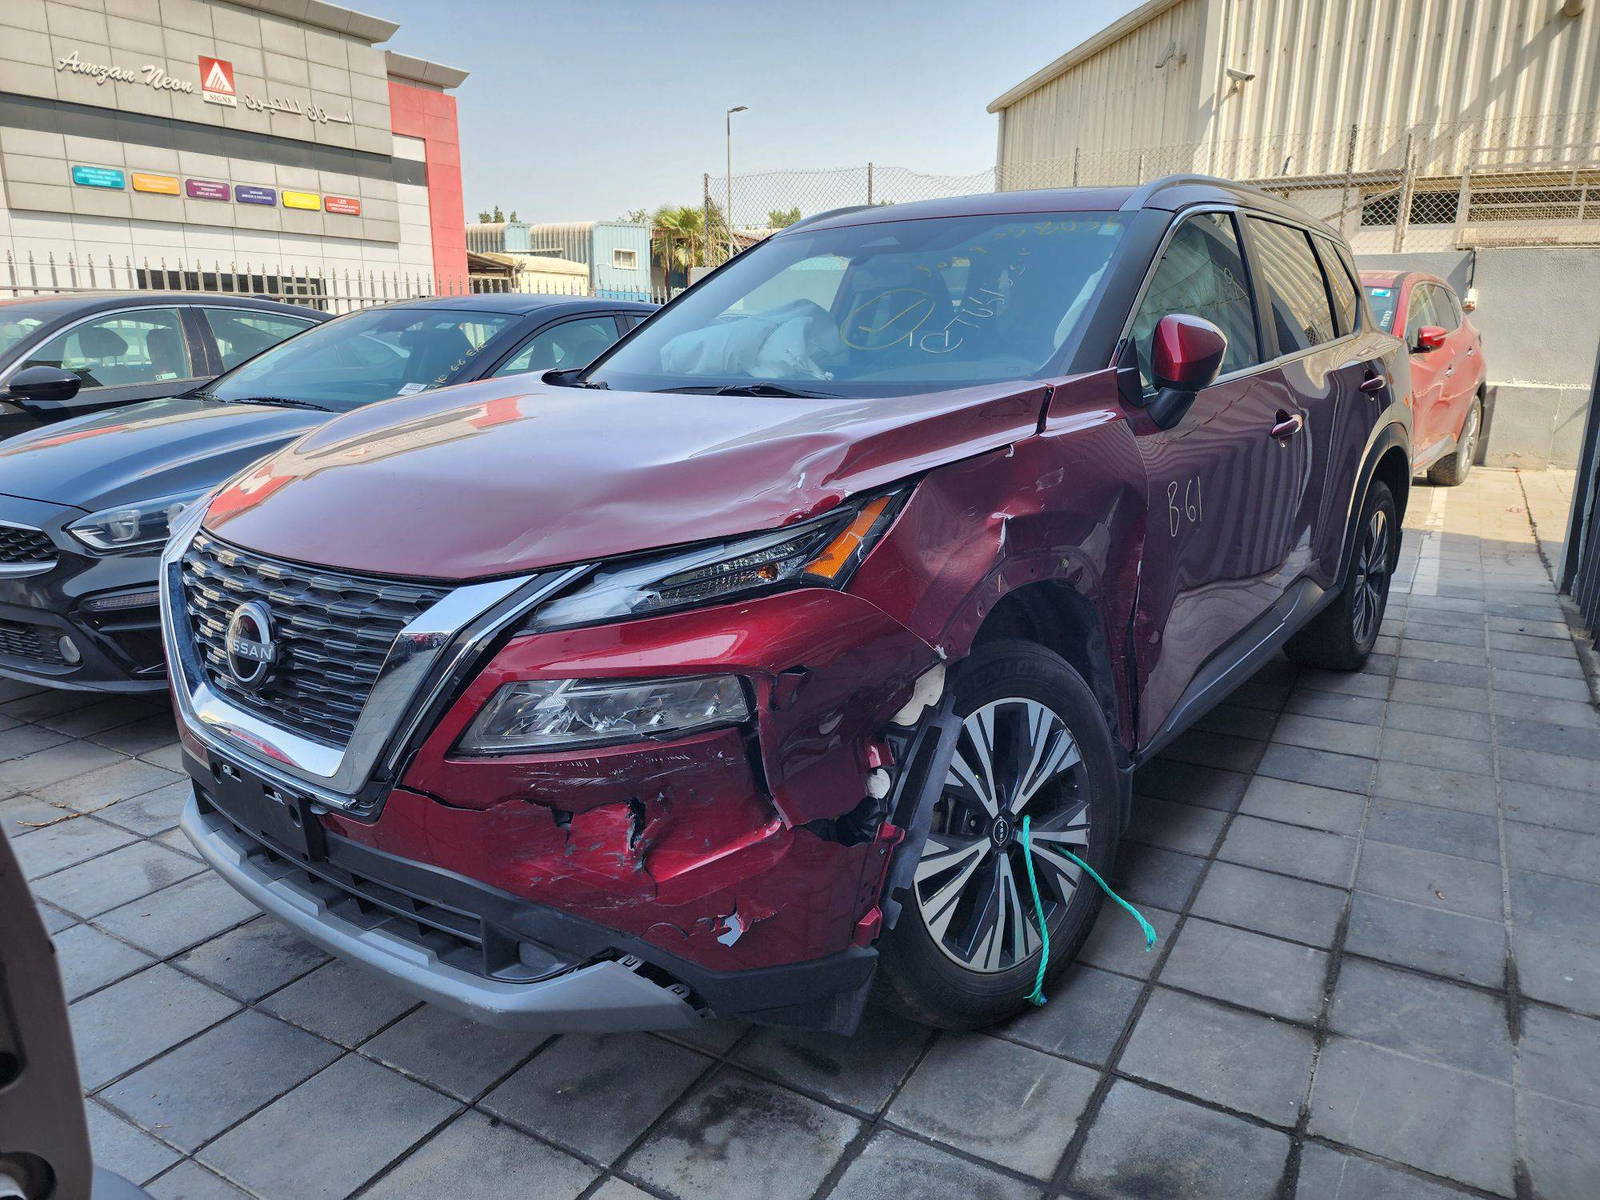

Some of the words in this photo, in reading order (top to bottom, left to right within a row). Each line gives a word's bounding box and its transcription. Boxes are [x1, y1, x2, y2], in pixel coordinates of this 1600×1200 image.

[57, 50, 136, 85] Amzan
[141, 64, 194, 95] Neon
[208, 95, 232, 105] SIGNS
